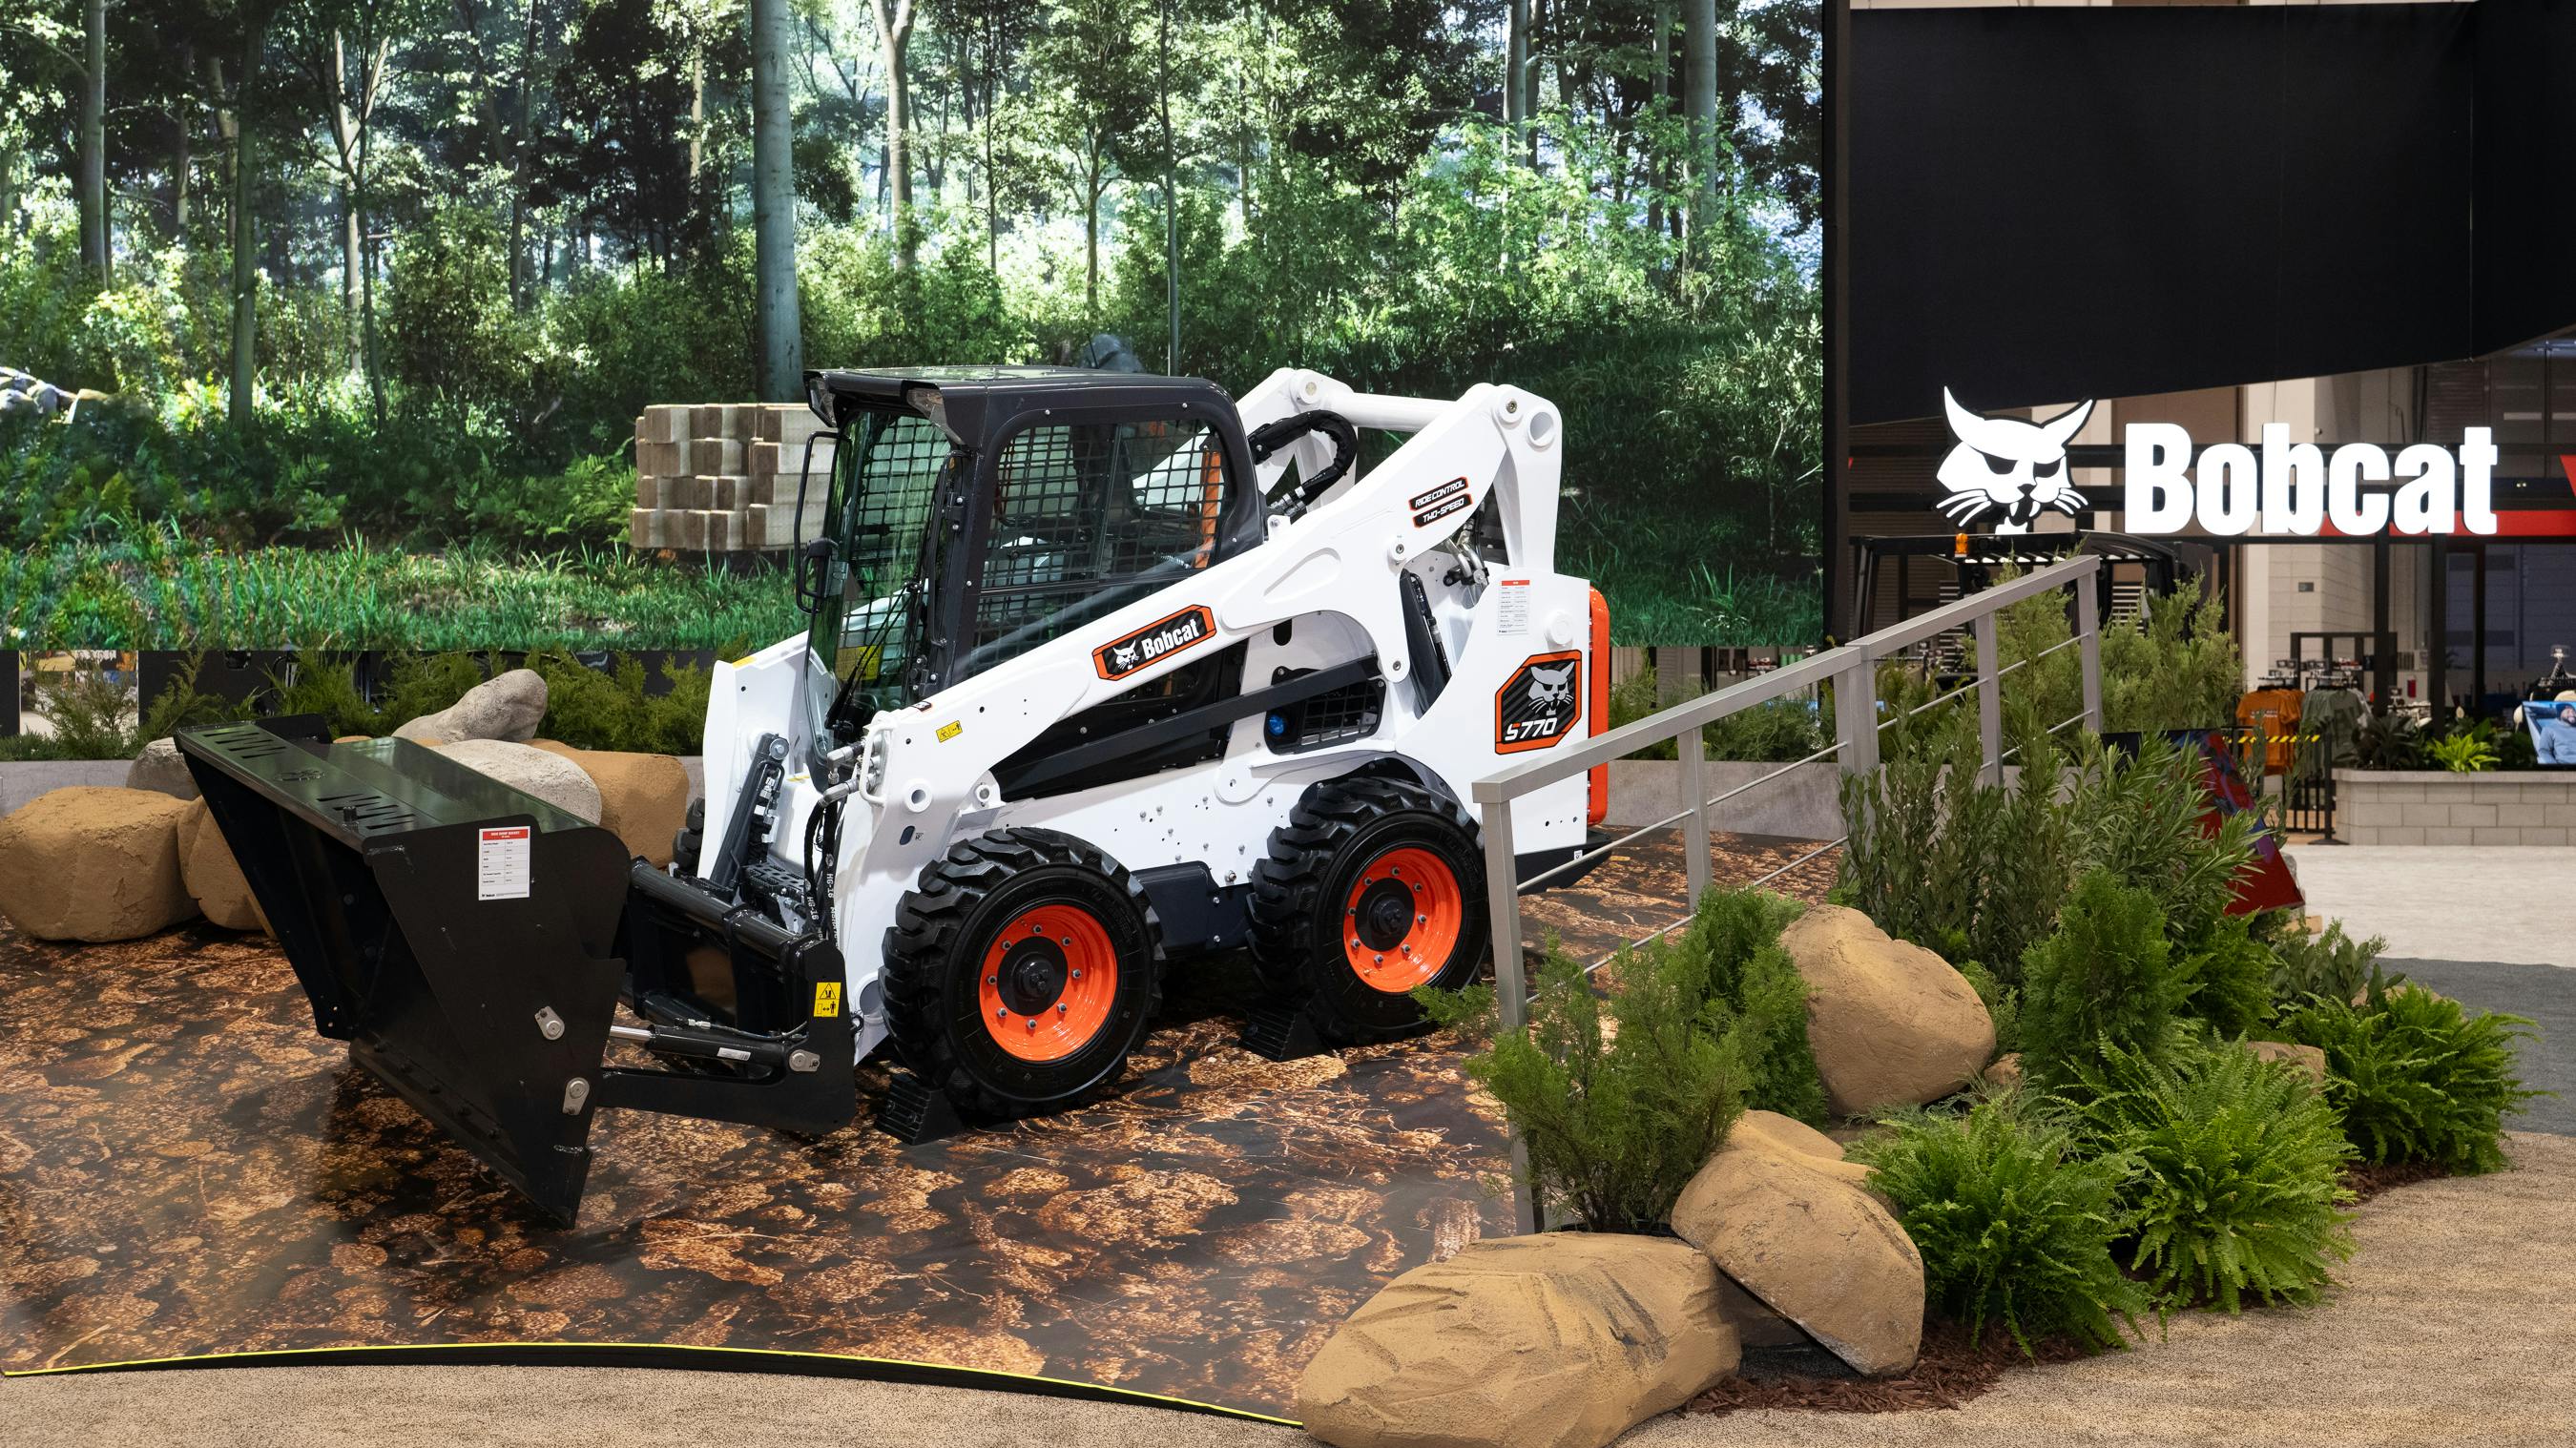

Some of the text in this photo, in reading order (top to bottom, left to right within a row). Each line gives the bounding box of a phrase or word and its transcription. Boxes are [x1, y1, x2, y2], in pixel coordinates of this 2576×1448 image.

[2125, 423, 2498, 535] Bobcat
[1415, 480, 1465, 507] RIDE CONTROL
[1423, 497, 1465, 523] TWO-SPEED
[1141, 618, 1200, 660] Bobcat
[1505, 717, 1558, 741] S770
